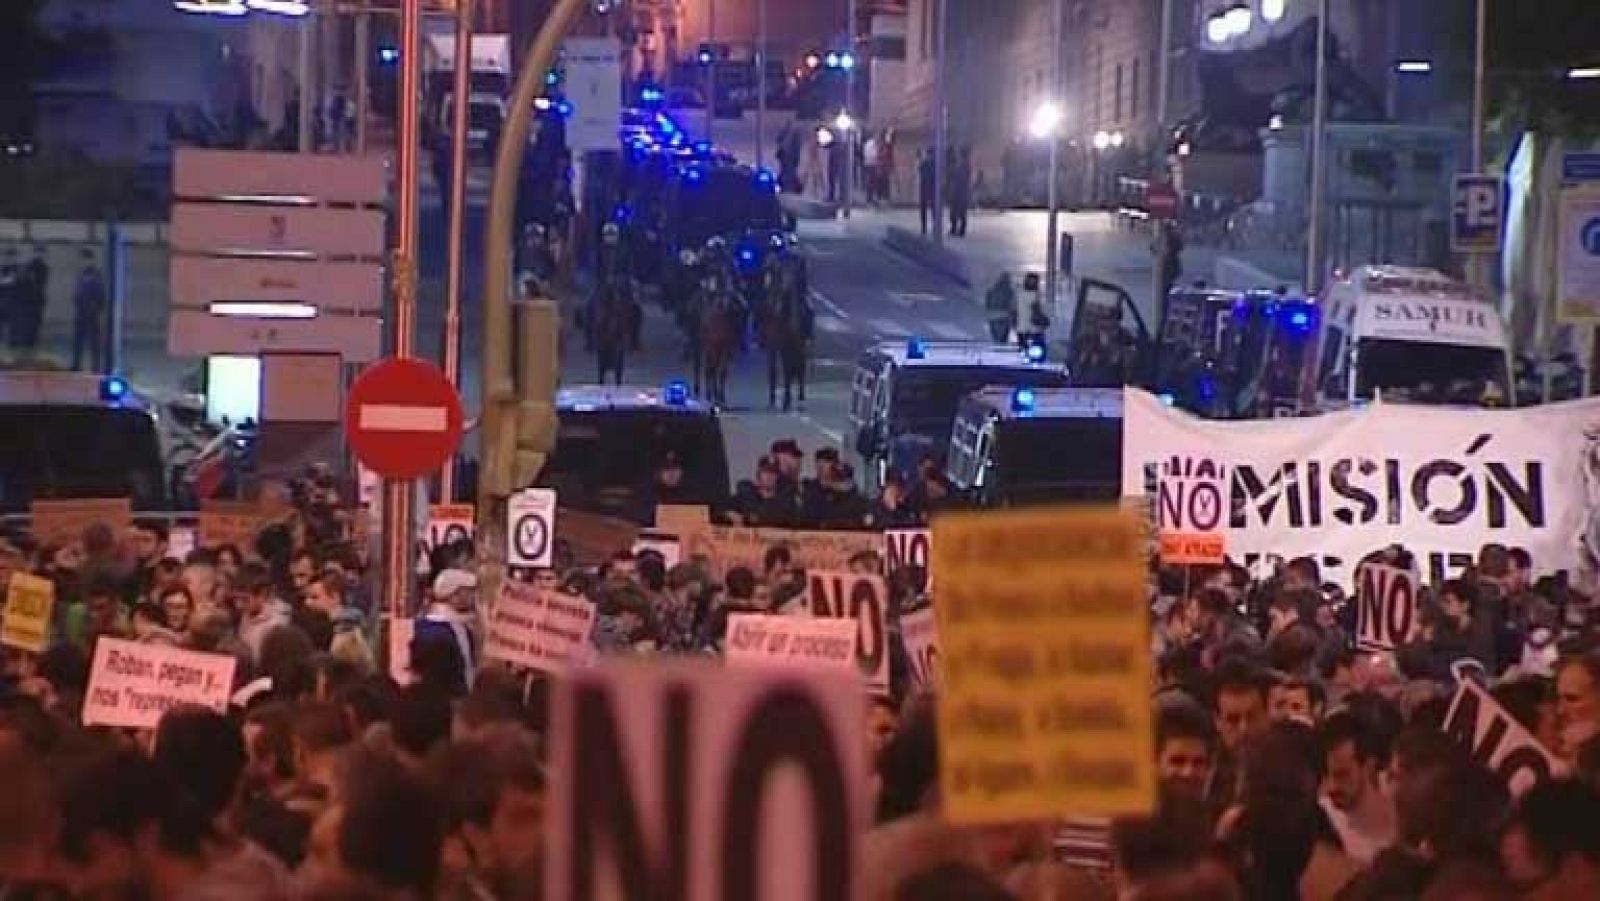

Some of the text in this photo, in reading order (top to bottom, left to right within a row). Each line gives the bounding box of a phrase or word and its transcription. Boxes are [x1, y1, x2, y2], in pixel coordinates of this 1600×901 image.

[1375, 303, 1487, 329] SAMUR
[1143, 433, 1547, 530] MISIÓN
[1159, 481, 1221, 531] NO
[1361, 566, 1412, 645] NO
[571, 676, 847, 901] NO
